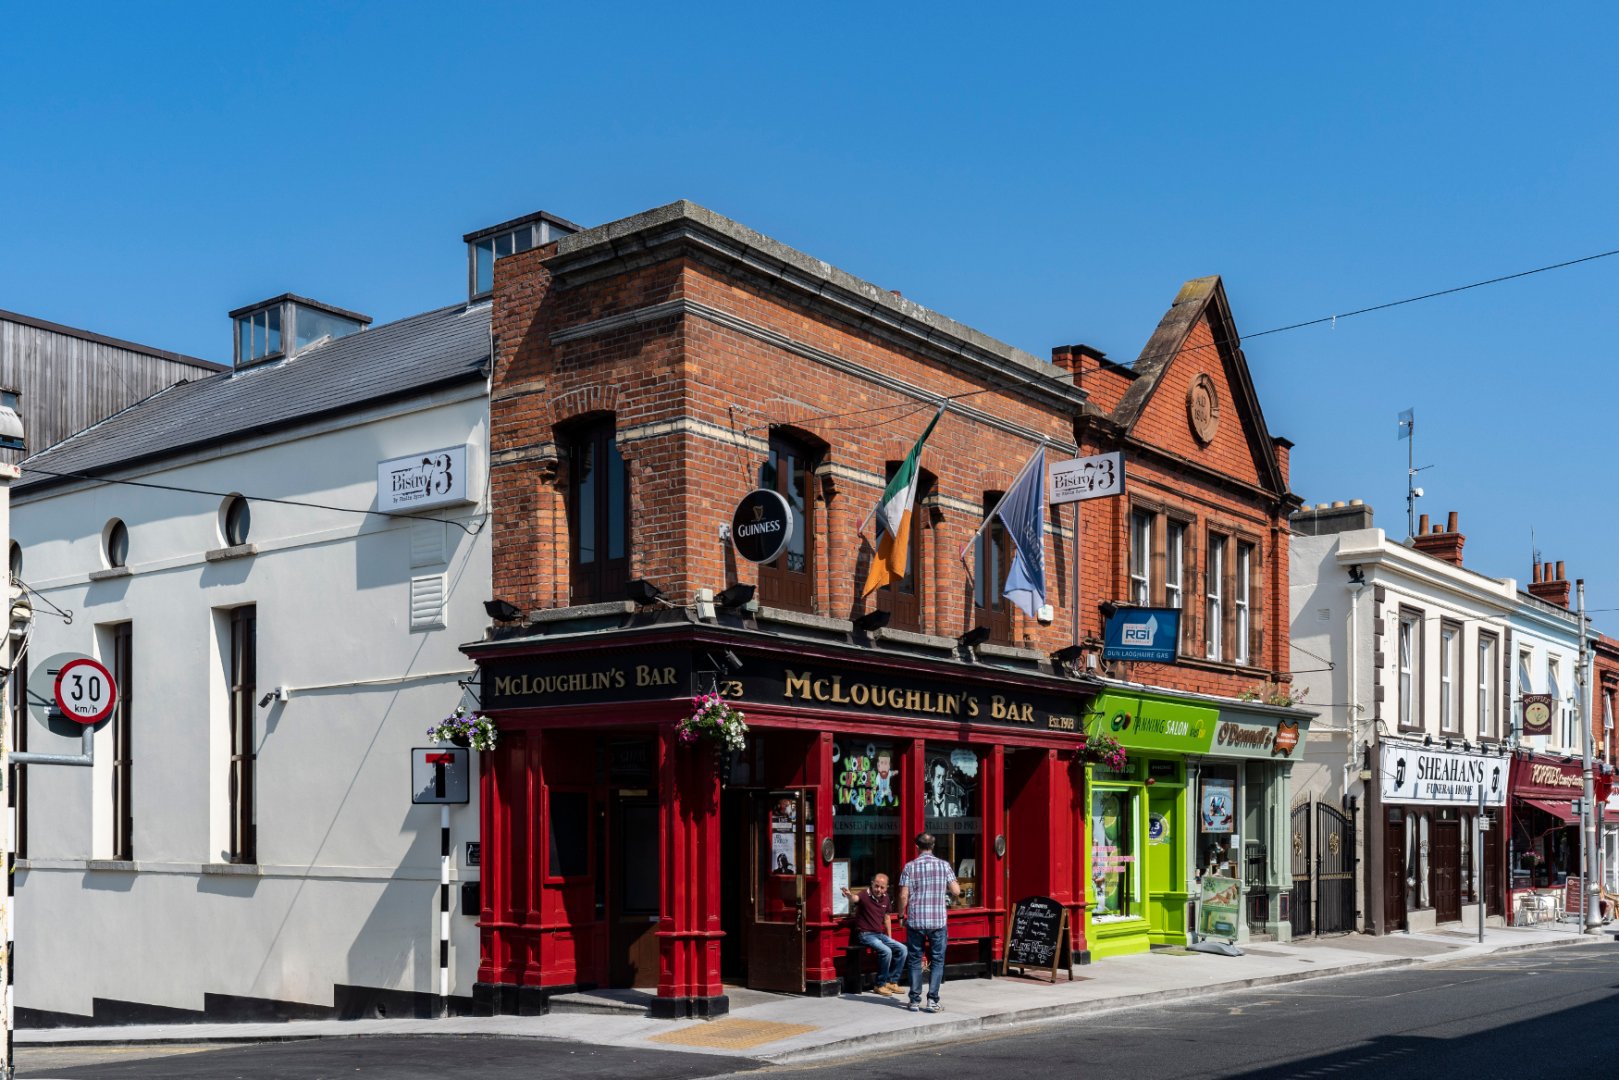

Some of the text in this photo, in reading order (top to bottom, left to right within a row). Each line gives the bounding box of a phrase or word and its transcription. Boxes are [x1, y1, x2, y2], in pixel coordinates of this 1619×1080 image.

[392, 453, 452, 496] Bistro 73
[1054, 459, 1115, 491] Bistro 73
[738, 519, 781, 538] GUINNESS
[1125, 629, 1150, 640] RGI
[71, 674, 100, 702] 30
[494, 664, 677, 697] MCLOUGHLIN'S BAR
[720, 680, 744, 697] 73
[784, 669, 1035, 723] MCLOUGHLIN'S BAR
[1524, 696, 1551, 704] POPPIES
[74, 704, 98, 714] km/h
[1132, 716, 1165, 734] TANNING
[1165, 720, 1189, 736] SALON
[844, 756, 870, 771] WORLD
[1417, 756, 1484, 783] SHEAHAN'S
[840, 769, 876, 788] CUP 2018
[1532, 764, 1561, 786] POPPIES
[839, 786, 857, 804] LIVE
[1426, 783, 1473, 795] FUNERAL HOME
